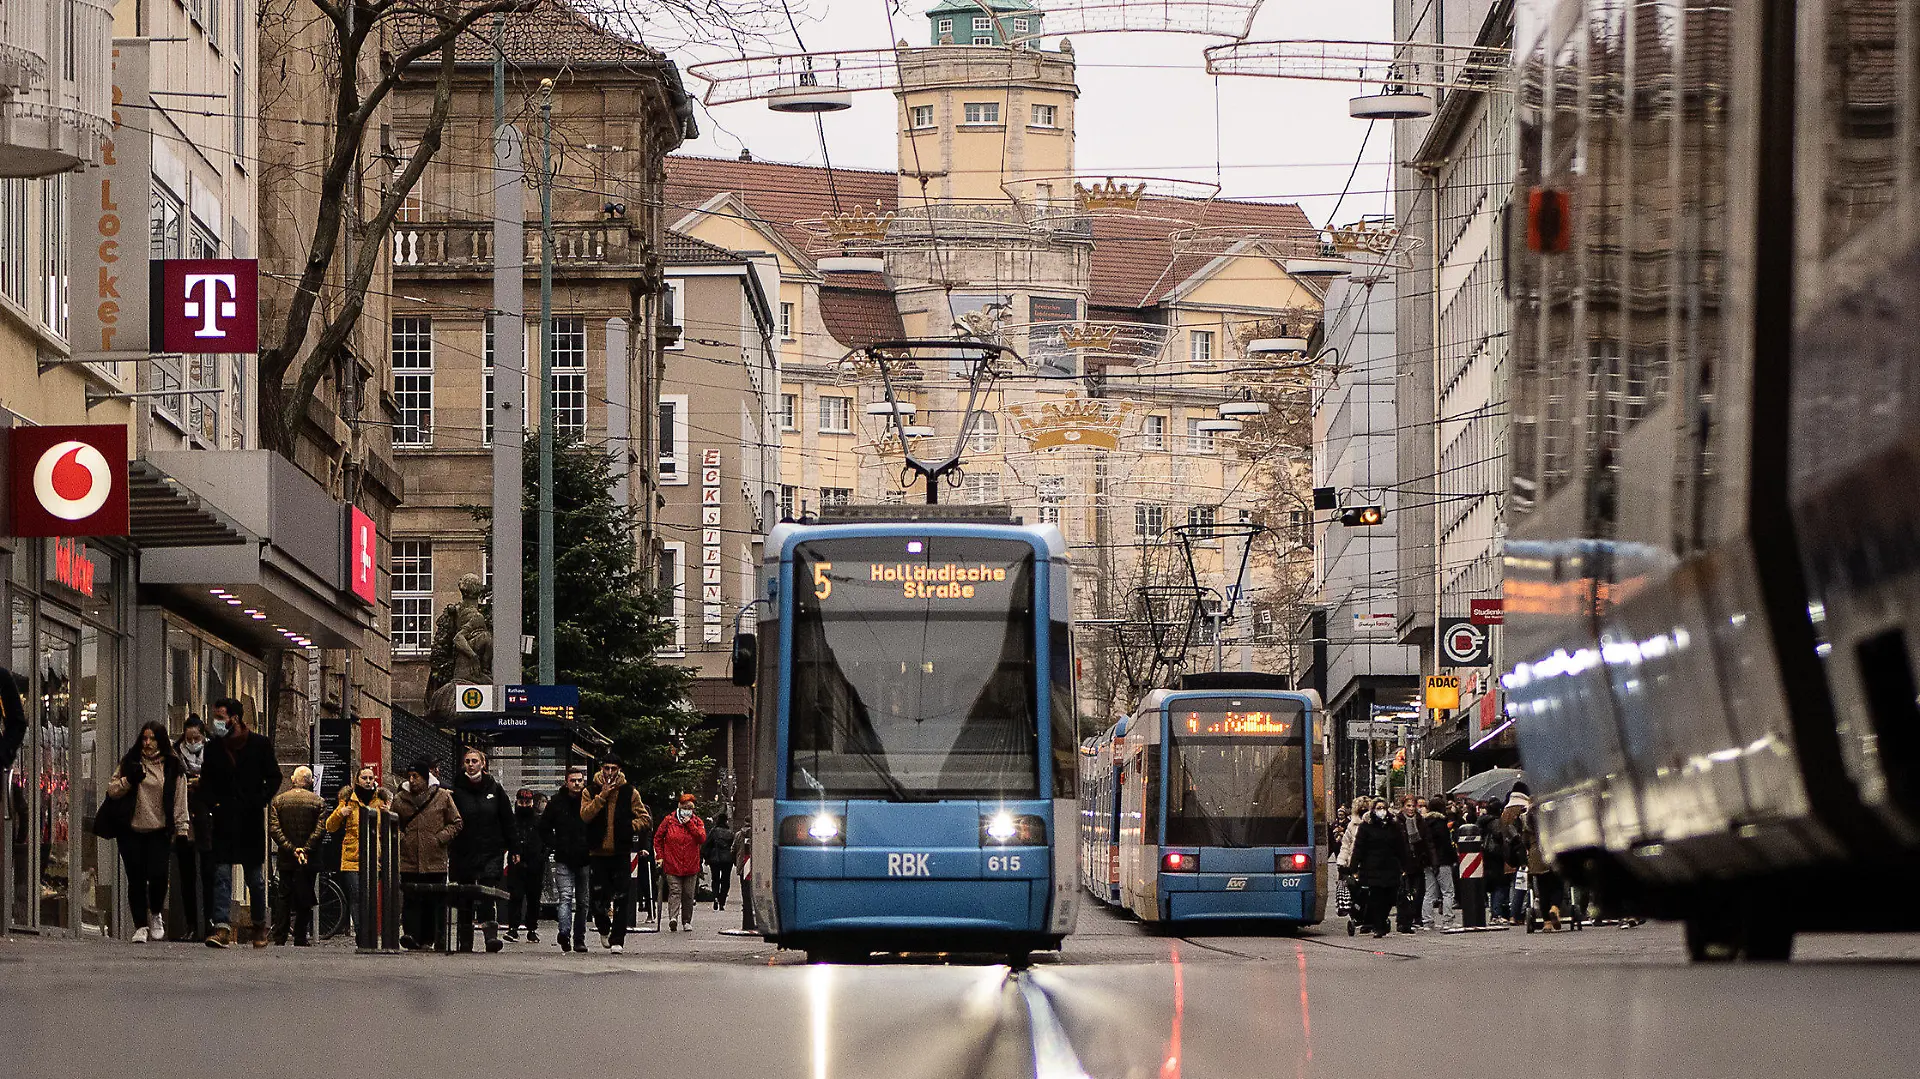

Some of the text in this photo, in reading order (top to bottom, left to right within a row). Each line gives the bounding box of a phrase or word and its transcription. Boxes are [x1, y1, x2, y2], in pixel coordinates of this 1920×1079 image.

[98, 179, 121, 351] Locker
[184, 274, 236, 337] T
[704, 450, 719, 598] ECKSTEIN
[814, 562, 832, 599] 5
[870, 564, 1006, 581] Holländische
[903, 581, 975, 599] Straße
[1428, 677, 1458, 688] ADAC
[498, 718, 527, 726] Rathaus
[888, 853, 930, 876] RBK
[988, 856, 1021, 871] 615
[1282, 878, 1300, 887] 607
